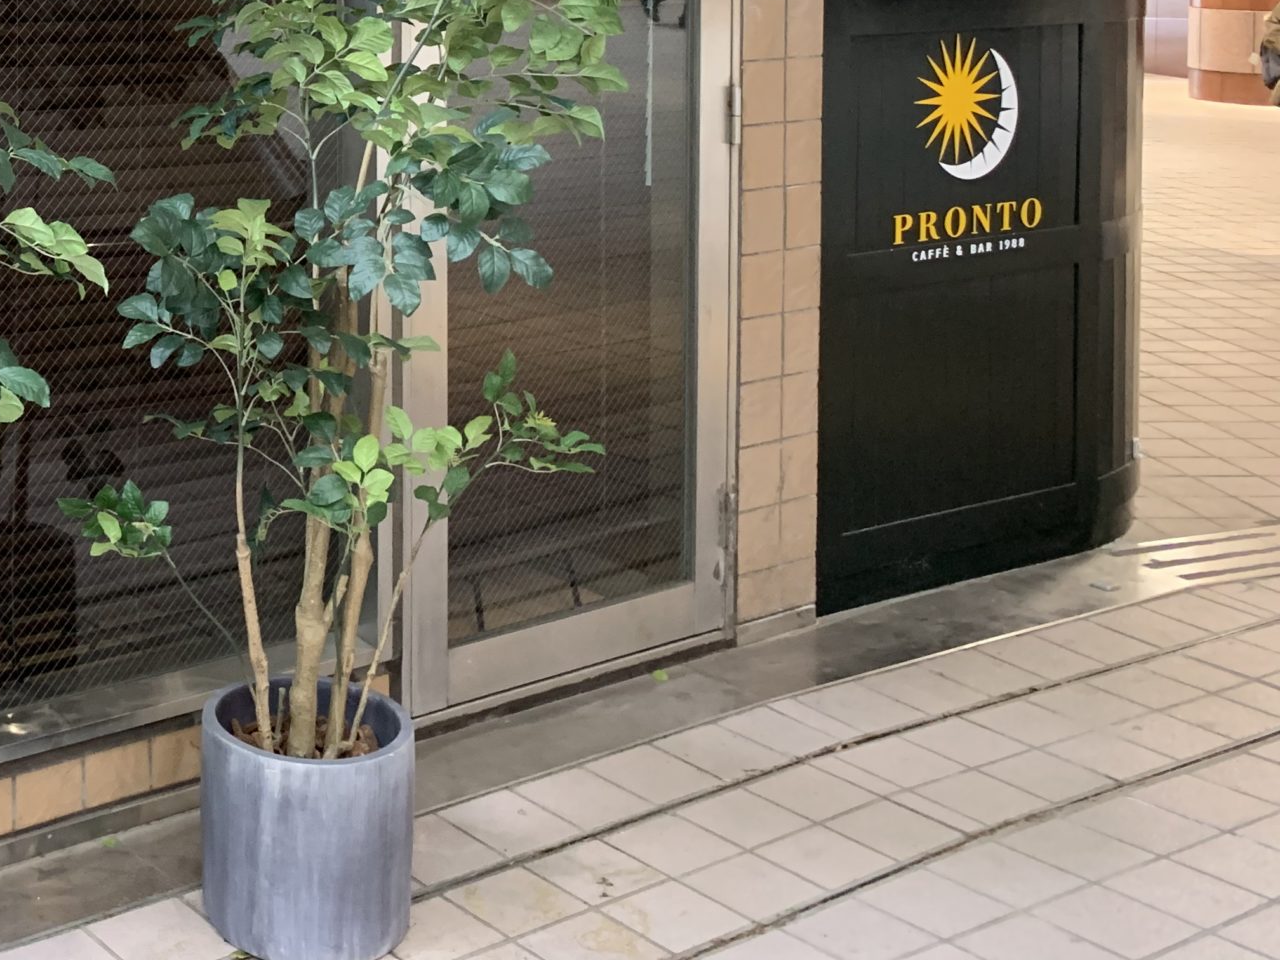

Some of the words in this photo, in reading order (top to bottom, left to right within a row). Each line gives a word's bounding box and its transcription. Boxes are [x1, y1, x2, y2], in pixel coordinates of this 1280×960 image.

[893, 197, 1042, 245] PRONTO
[912, 245, 950, 261] CAFFÈ
[955, 245, 964, 256] &
[970, 243, 993, 254] BAR
[999, 238, 1025, 250] 1988
